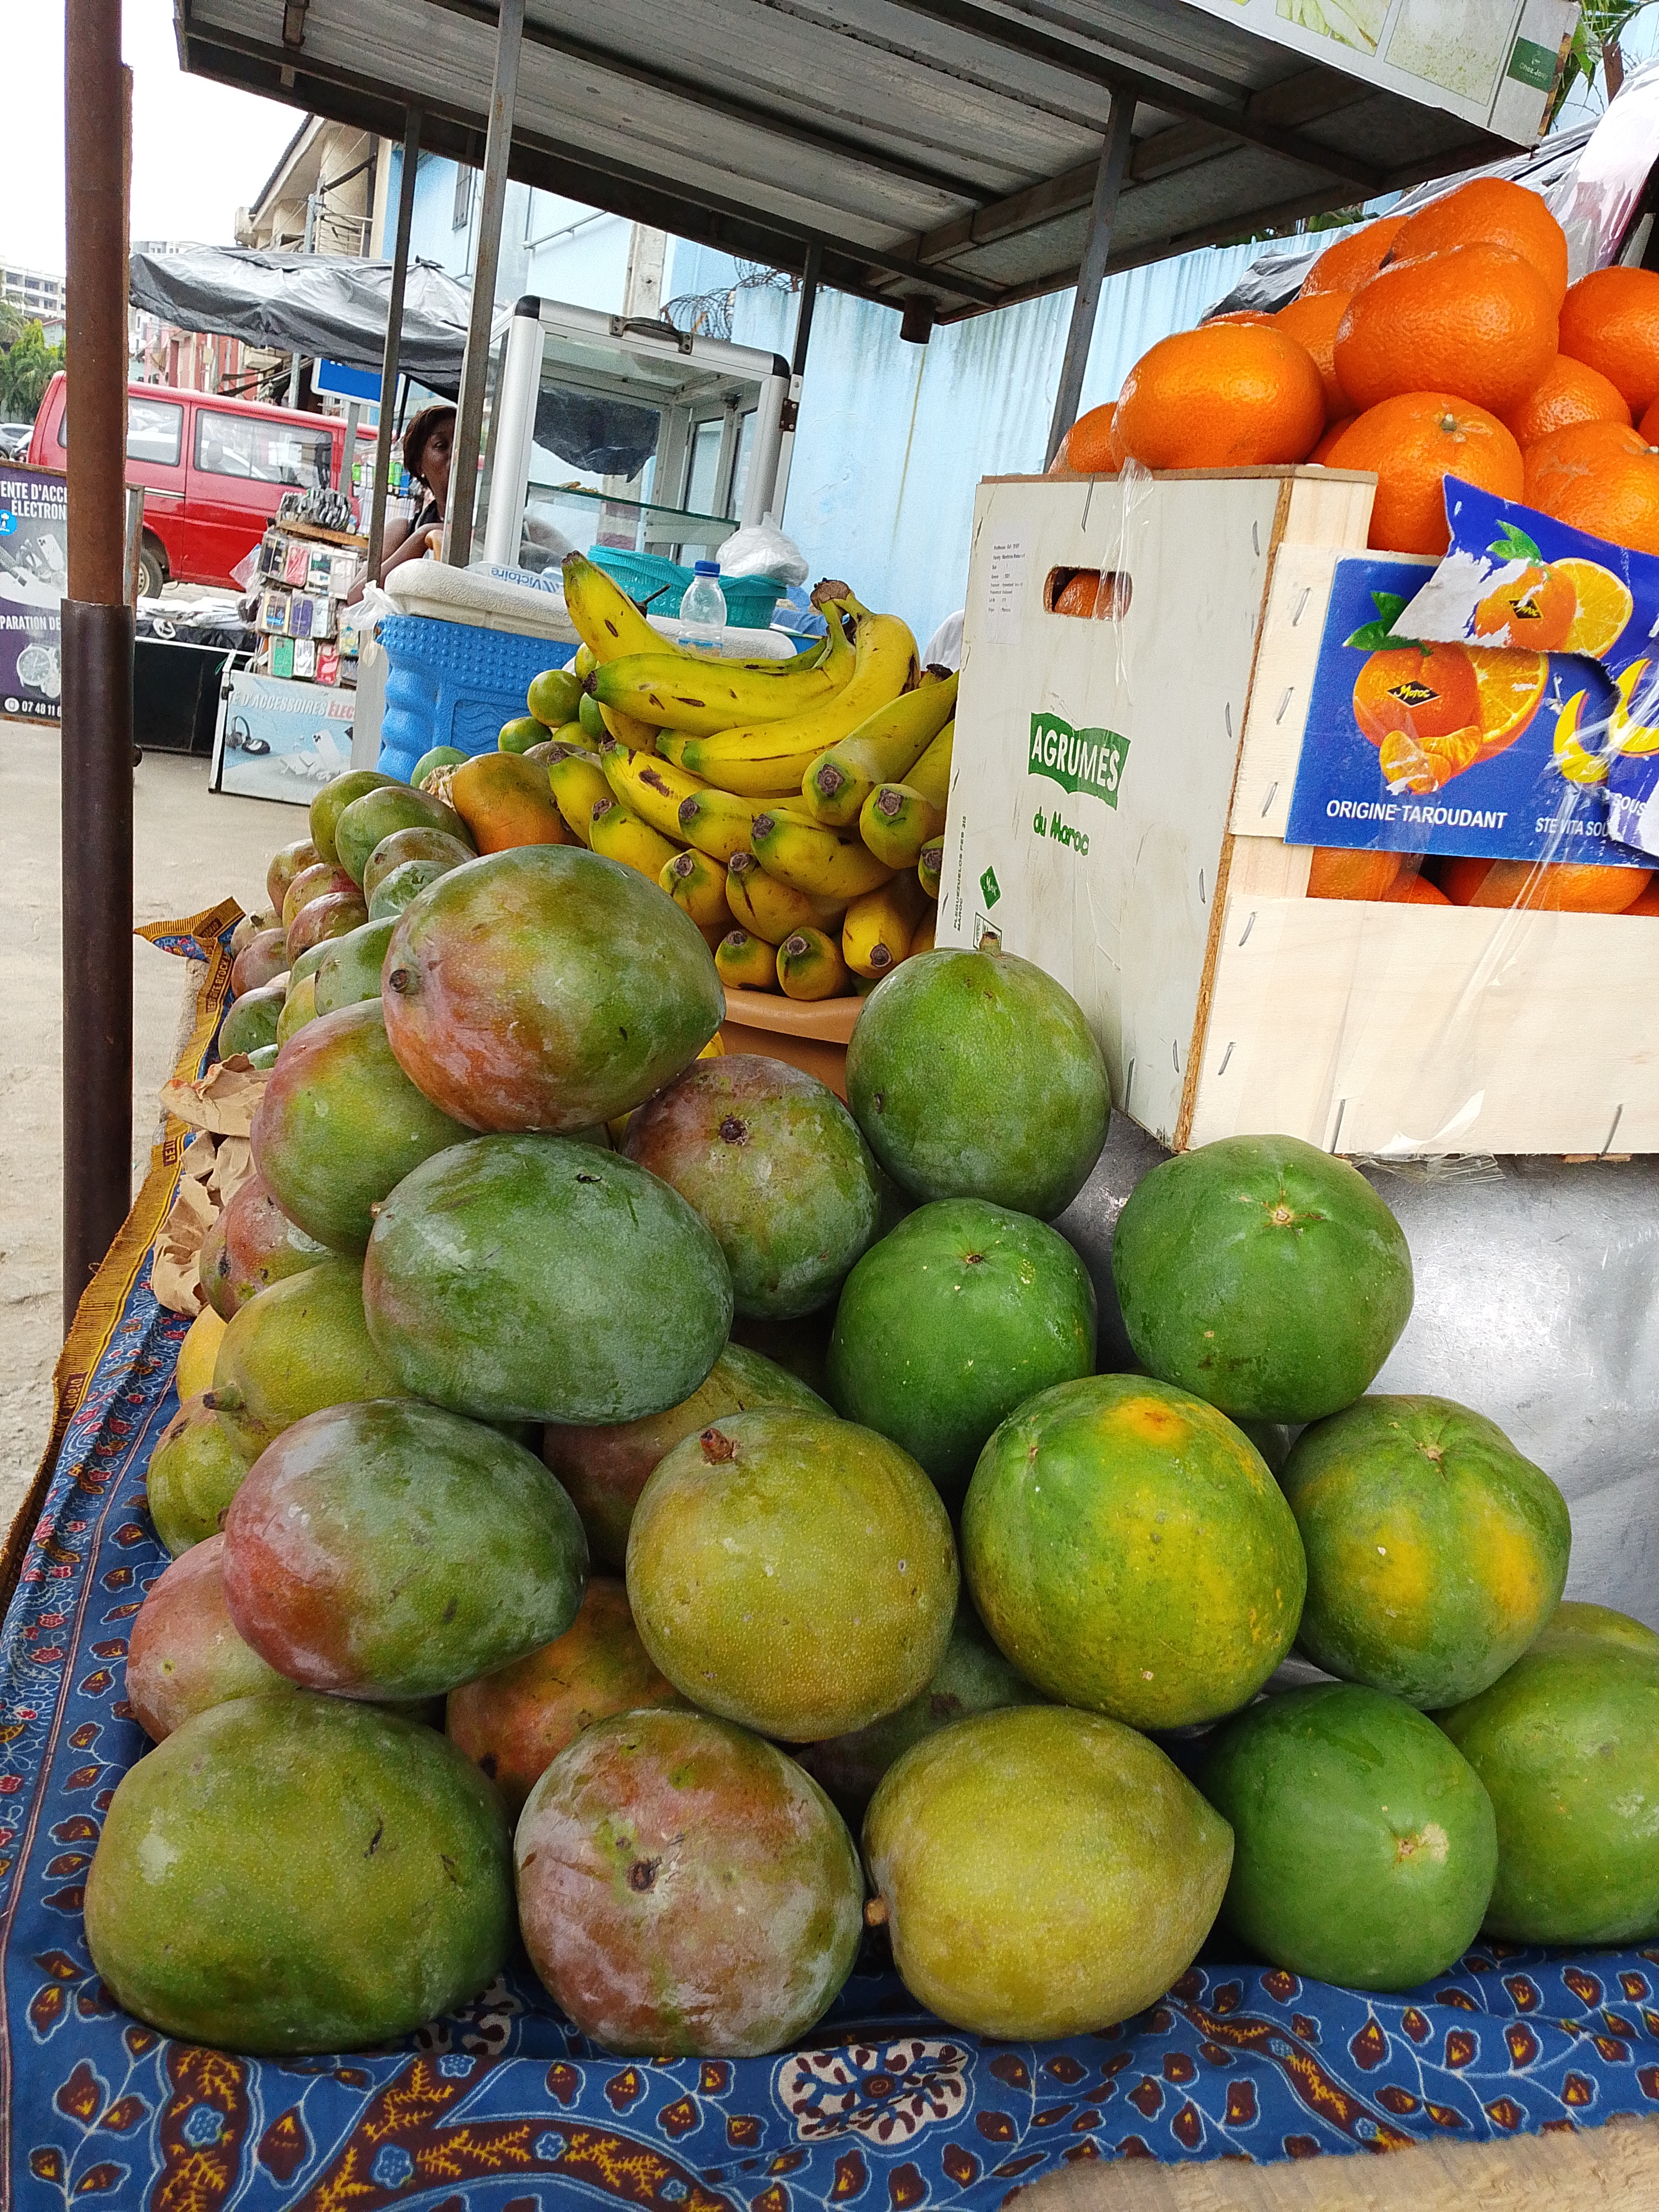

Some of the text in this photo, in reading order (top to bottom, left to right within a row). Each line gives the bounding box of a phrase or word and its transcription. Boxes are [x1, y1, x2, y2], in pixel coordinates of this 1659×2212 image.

[0, 481, 28, 499] ENTE
[491, 567, 541, 590] Victoire
[0, 615, 47, 630] PARATION
[1393, 684, 1430, 700] Maroc
[22, 700, 33, 713] 07
[47, 705, 55, 716] 11
[1032, 725, 1120, 791] AGRUMES
[1326, 800, 1508, 829] ORIGINE TAROUDANT
[1033, 806, 1090, 856] du Maroc
[1535, 817, 1557, 833] STE
